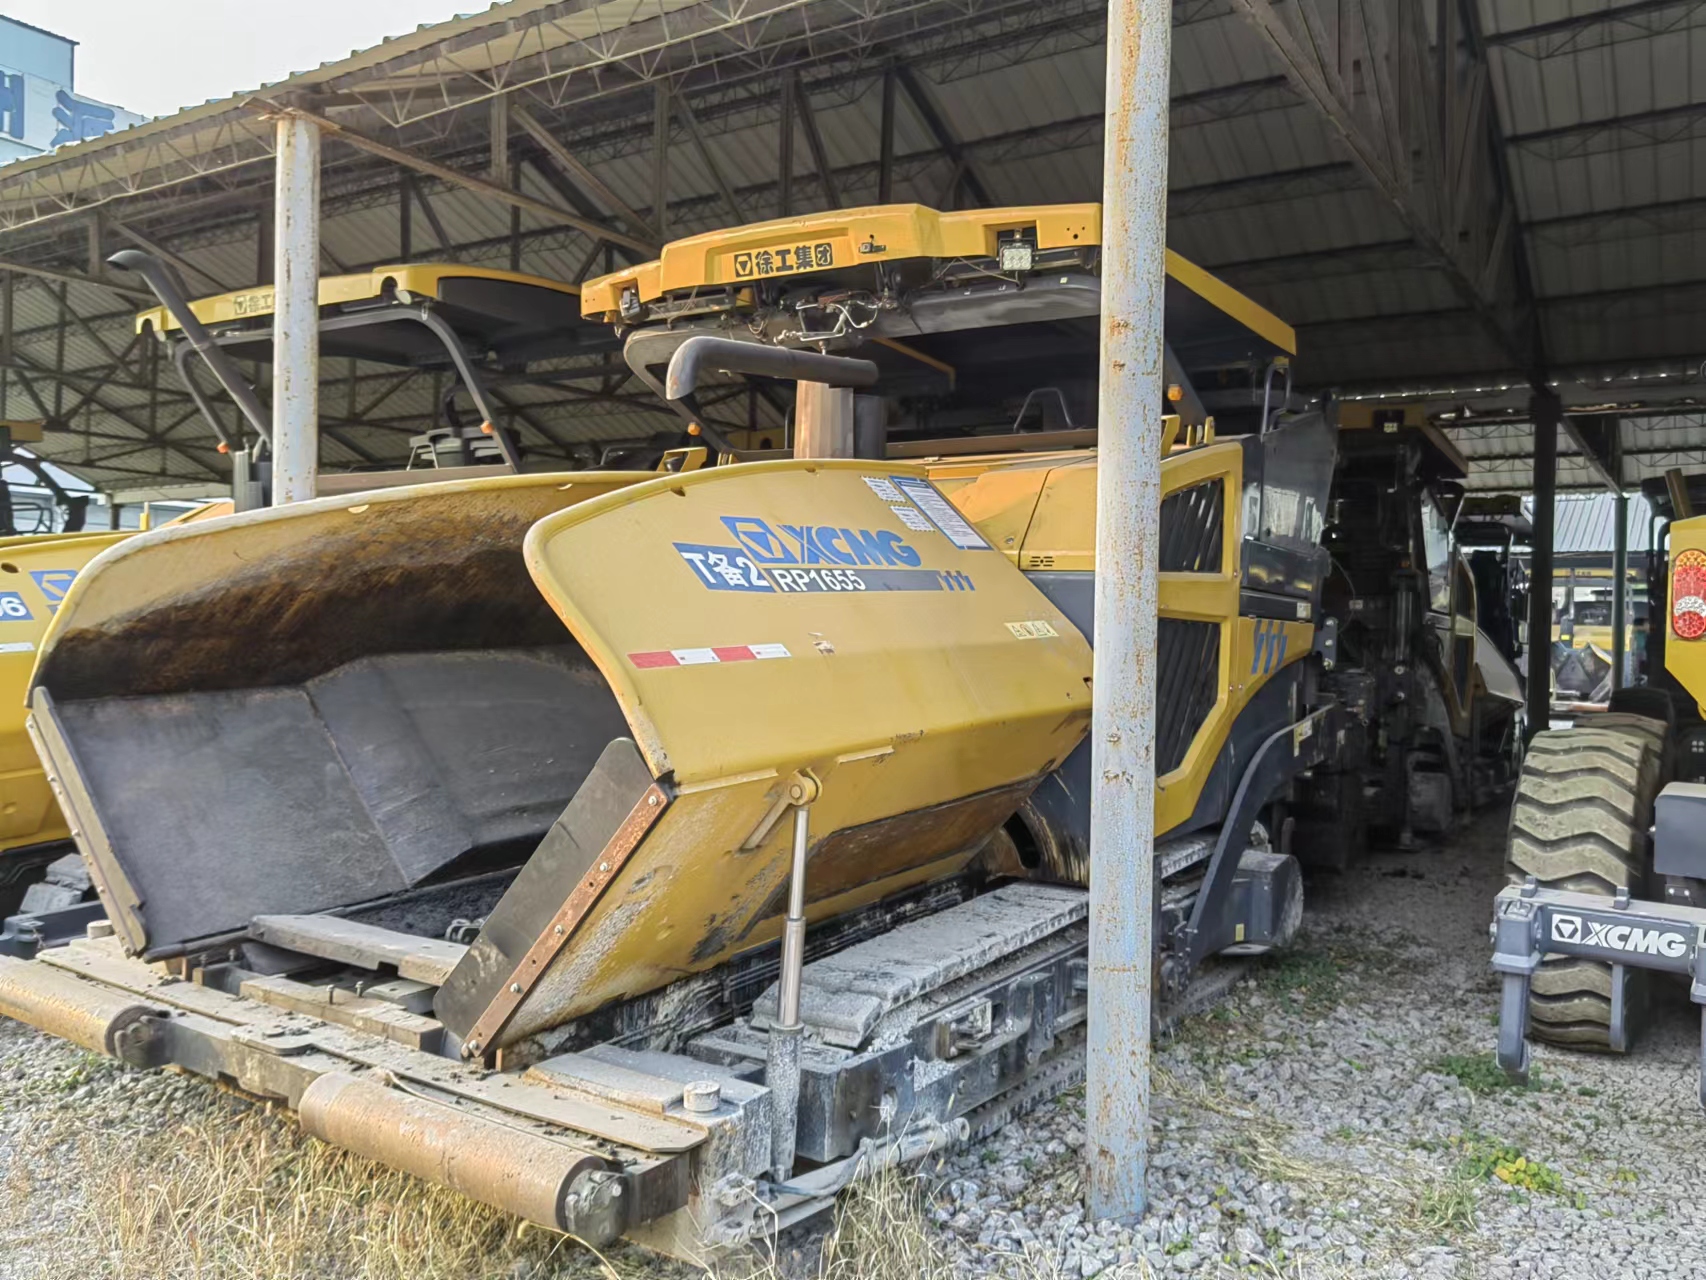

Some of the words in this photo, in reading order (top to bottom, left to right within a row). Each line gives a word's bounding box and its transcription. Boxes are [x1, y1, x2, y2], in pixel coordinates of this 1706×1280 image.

[755, 242, 833, 275] 徐工集团
[776, 524, 922, 567] XCMG
[680, 551, 771, 588] T备2
[771, 569, 867, 592] RP1655
[0, 597, 27, 617] 6
[1581, 921, 1687, 958] XCMG
